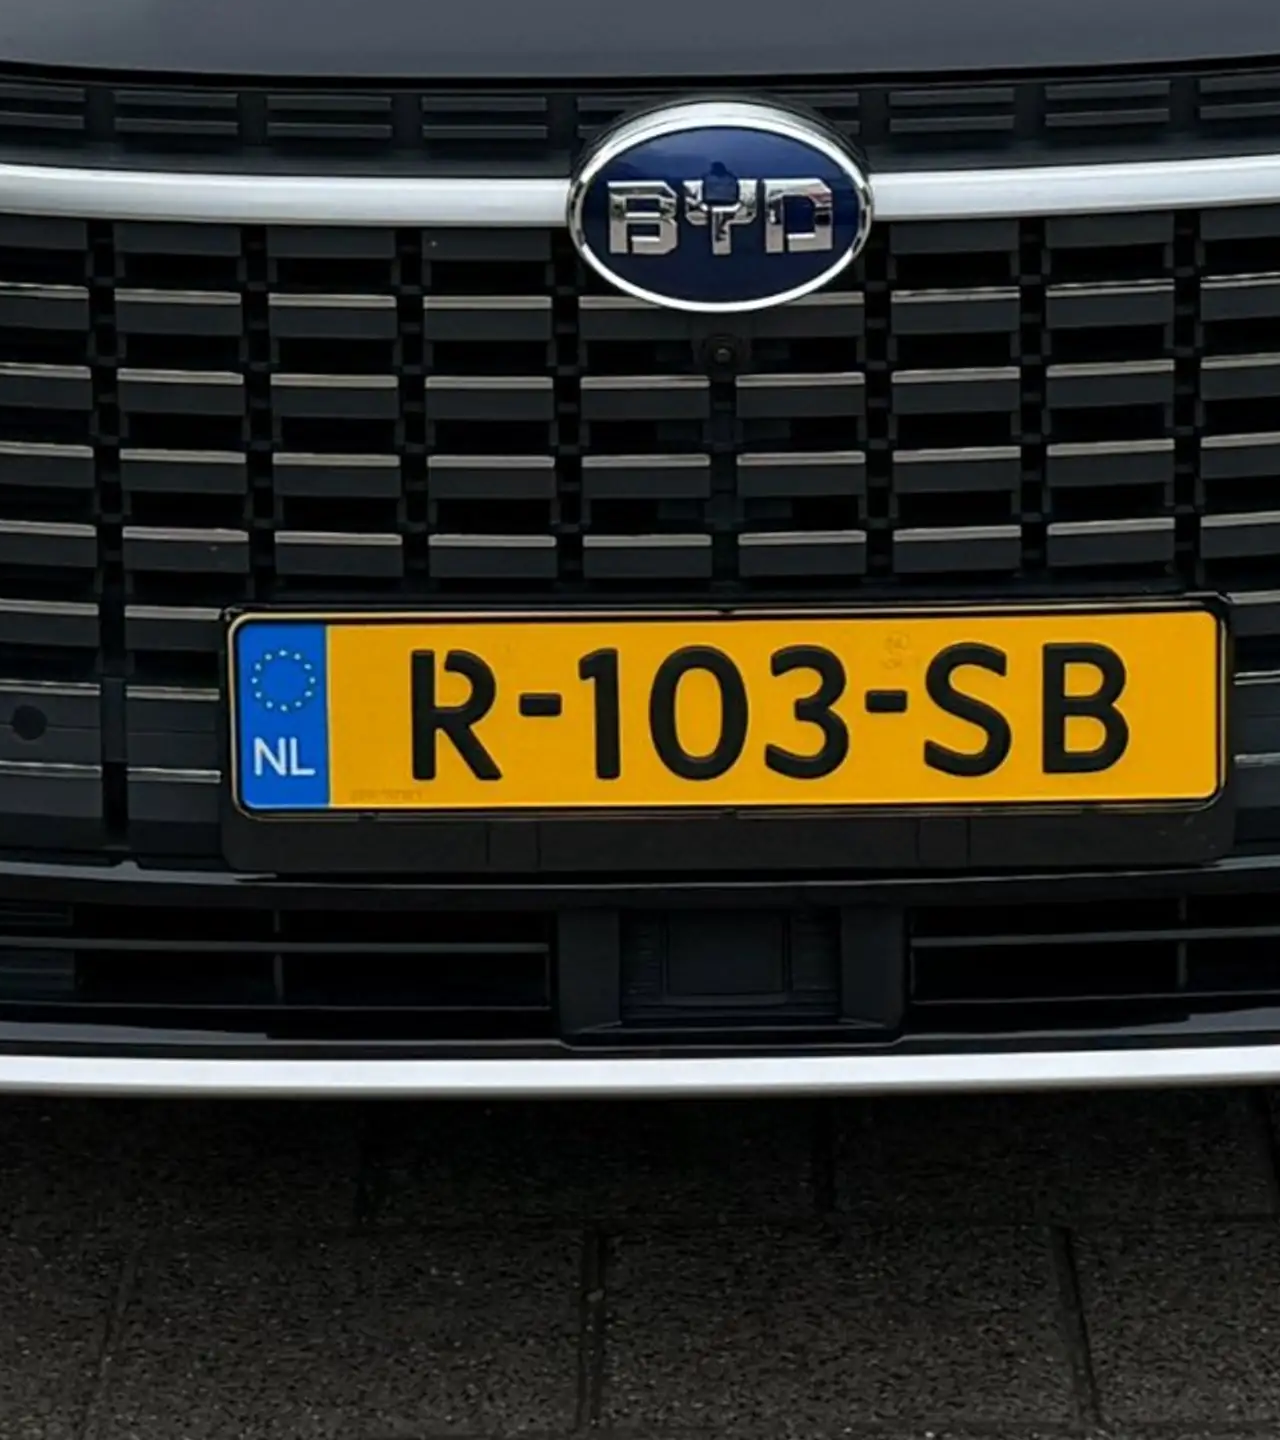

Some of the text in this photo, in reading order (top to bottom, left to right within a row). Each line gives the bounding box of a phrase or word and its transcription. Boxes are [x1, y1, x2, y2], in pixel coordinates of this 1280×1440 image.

[608, 177, 834, 255] BYD
[409, 642, 1130, 782] R-103-SB
[252, 735, 315, 777] NL
